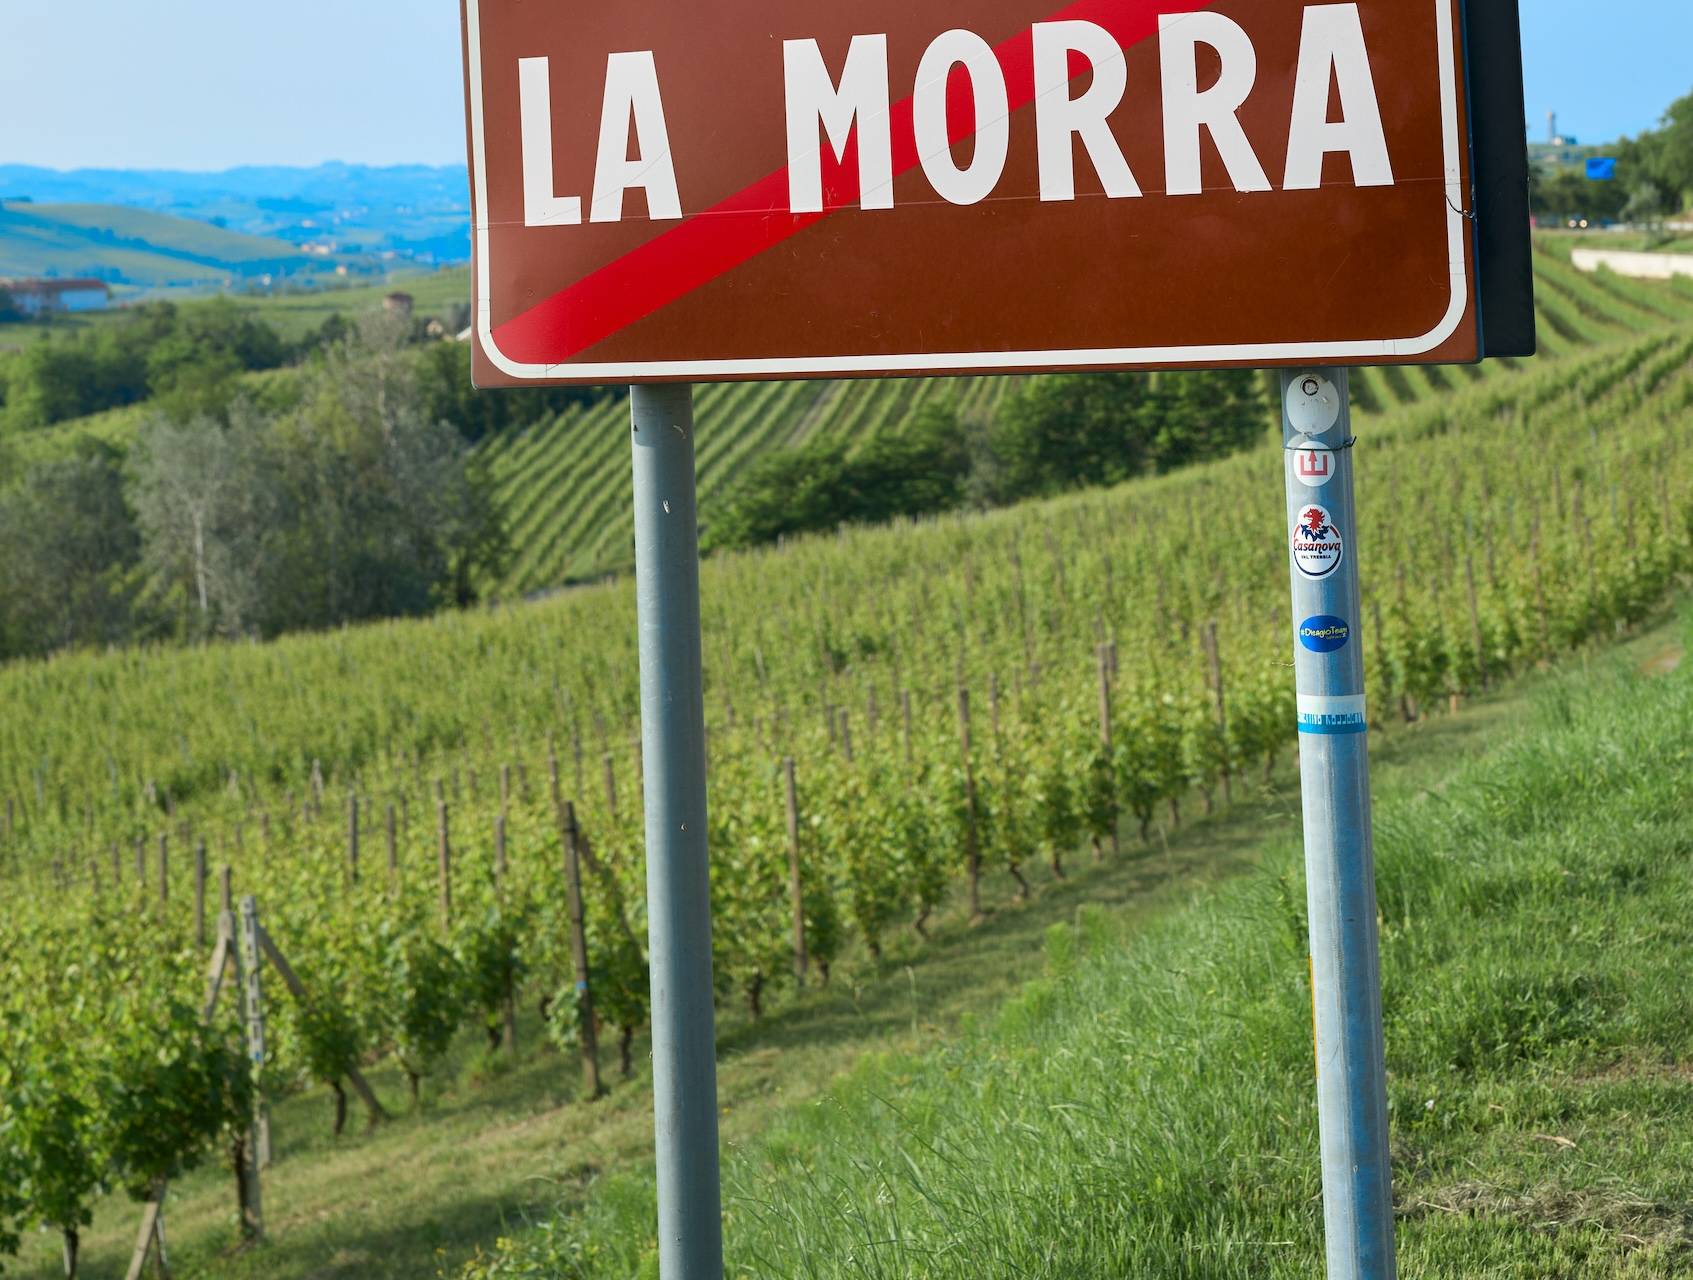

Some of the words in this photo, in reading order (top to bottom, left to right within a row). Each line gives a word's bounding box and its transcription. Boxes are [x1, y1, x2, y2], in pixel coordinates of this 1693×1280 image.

[518, 50, 683, 228] LA
[782, 1, 1395, 215] MORRA
[1294, 538, 1341, 554] Casanova
